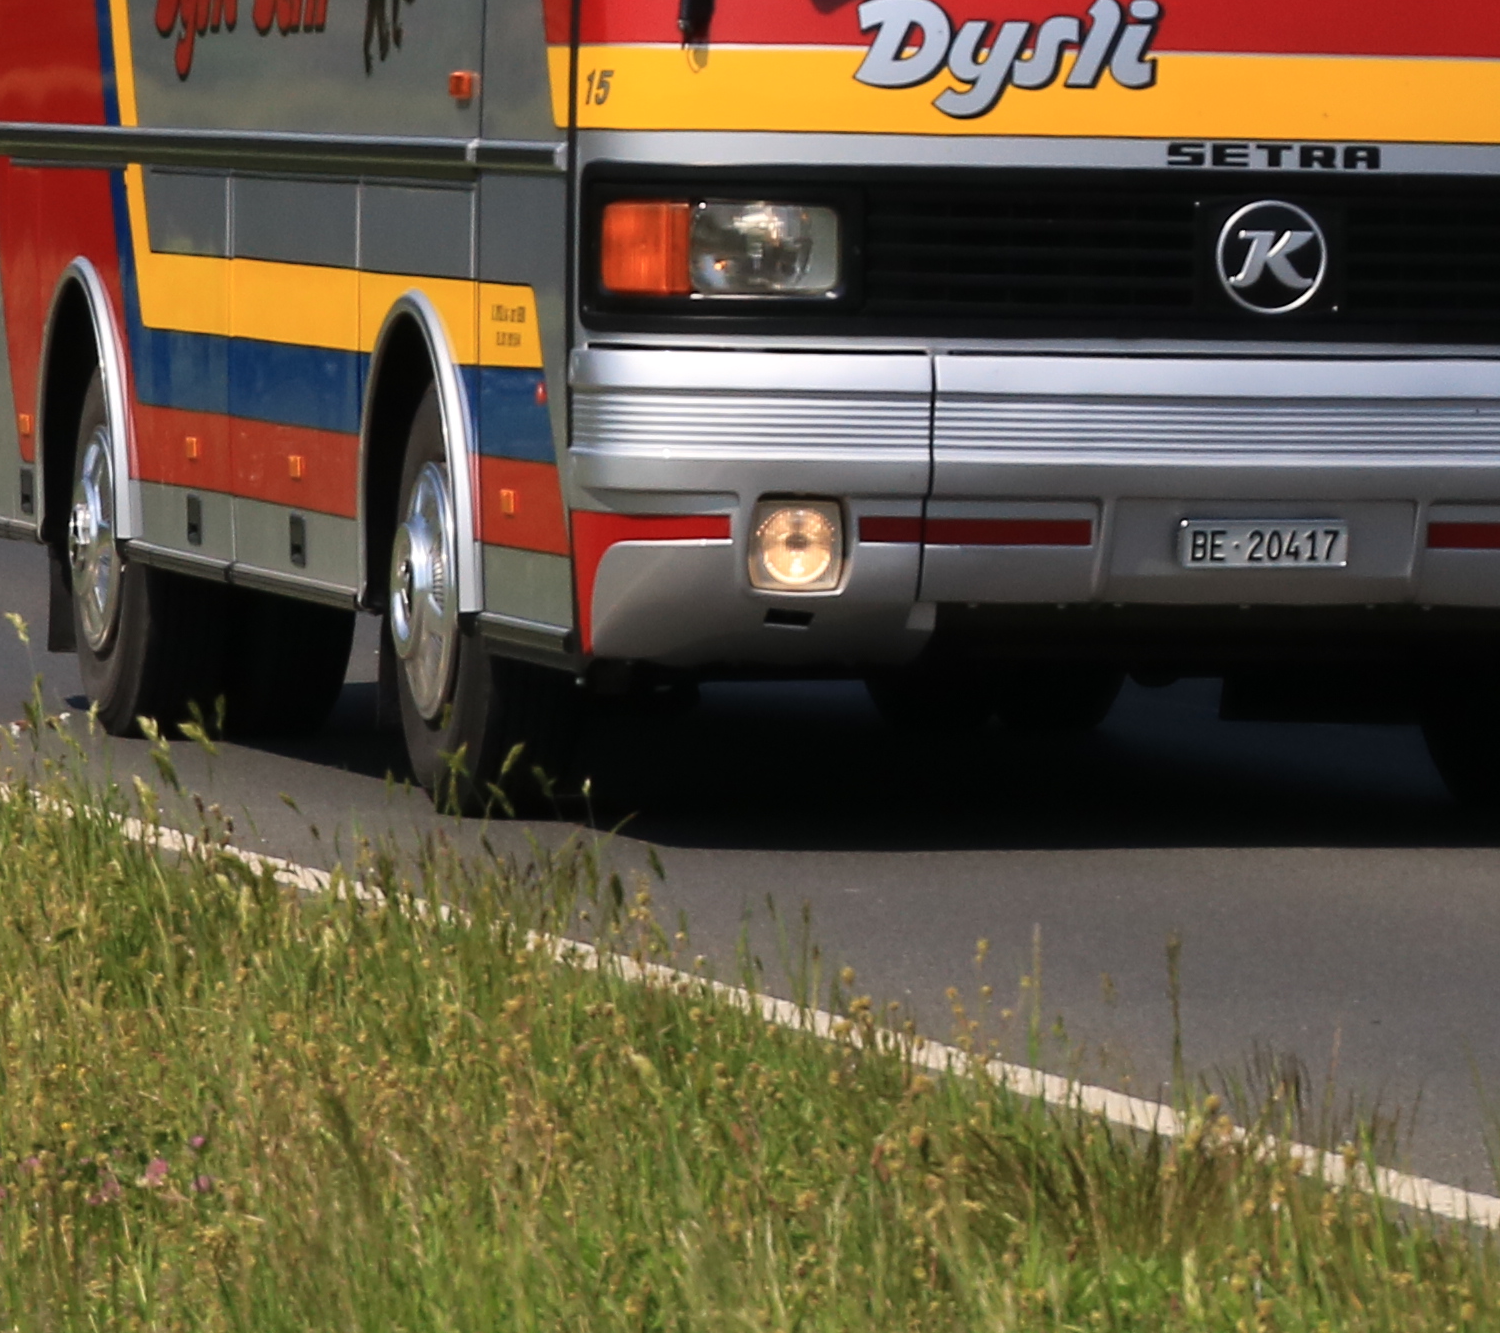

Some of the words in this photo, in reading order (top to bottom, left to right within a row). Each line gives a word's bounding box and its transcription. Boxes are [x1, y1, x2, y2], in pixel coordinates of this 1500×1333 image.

[585, 68, 615, 105] 15
[1167, 142, 1380, 170] SETRA
[1191, 530, 1226, 562] BE
[1247, 530, 1340, 562] 20417
